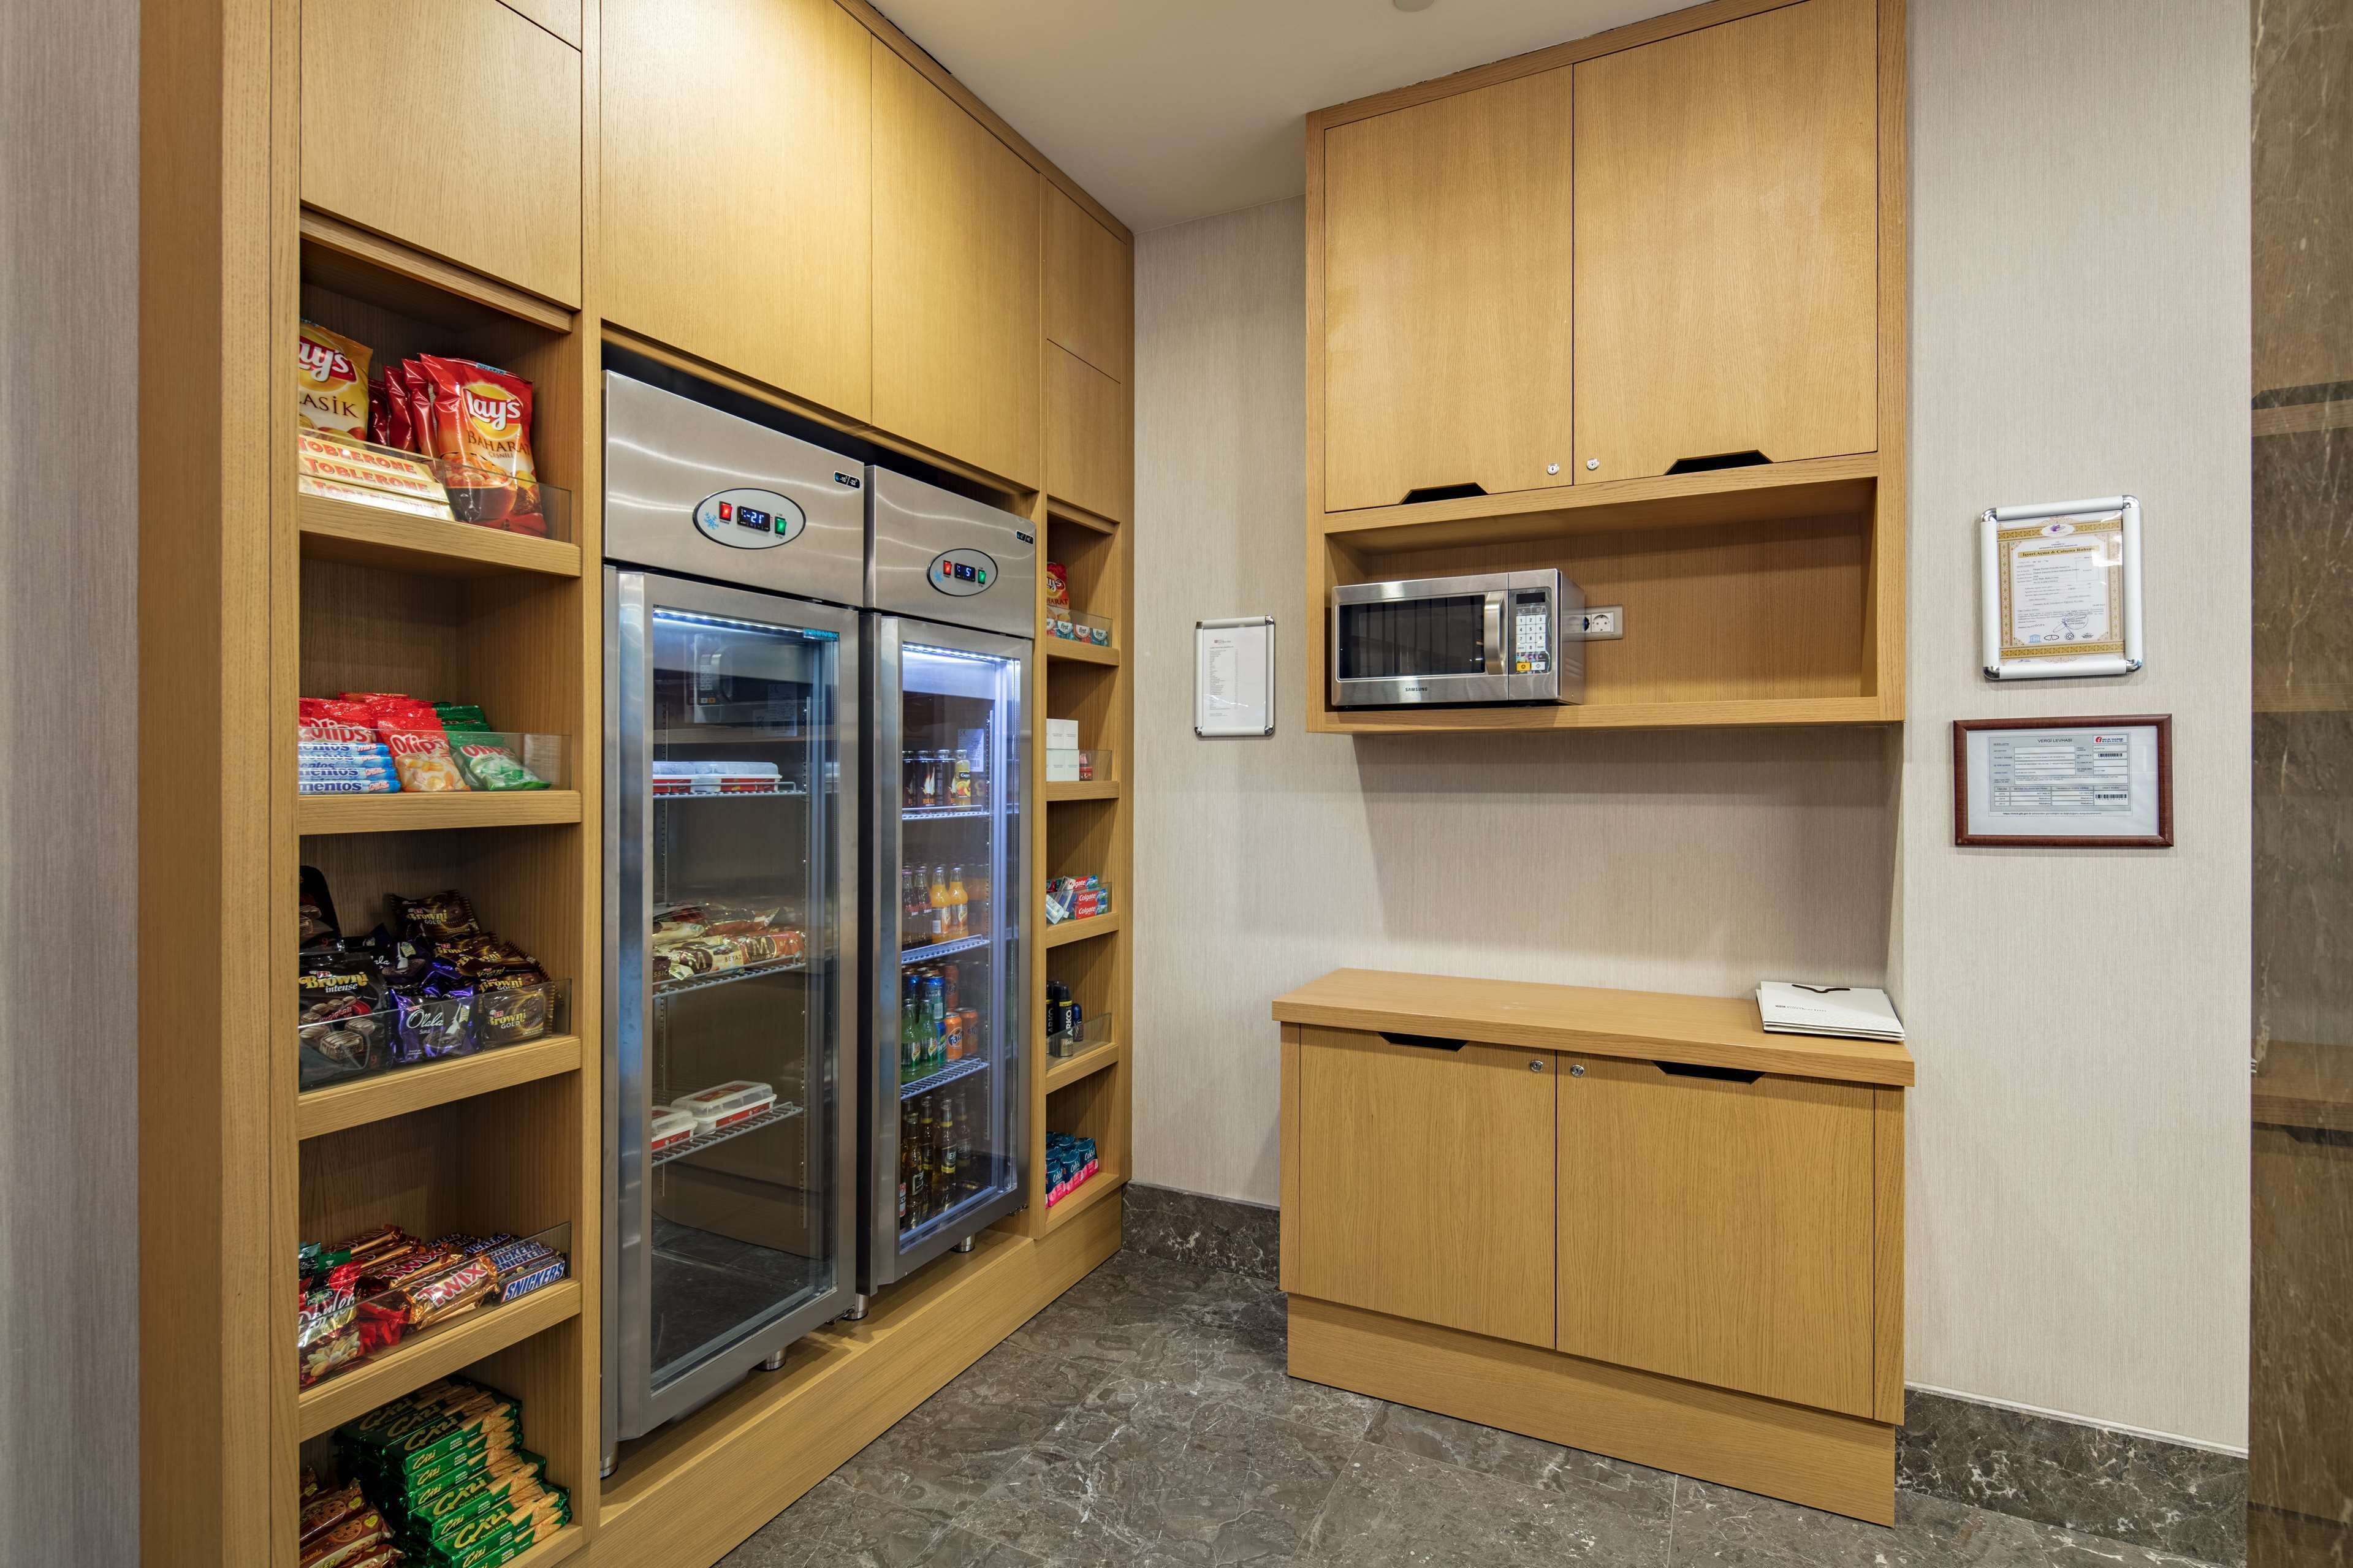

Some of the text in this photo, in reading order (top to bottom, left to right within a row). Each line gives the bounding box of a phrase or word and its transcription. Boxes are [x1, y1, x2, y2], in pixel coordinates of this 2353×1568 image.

[299, 393, 360, 419] ASİK
[466, 390, 521, 431] Lay's
[298, 436, 417, 475] TOBLERONE
[304, 457, 428, 493] TOBLERONE
[309, 718, 368, 743] Olips
[389, 734, 447, 756] Olips
[299, 782, 362, 792] mentos
[1079, 893, 1096, 902] Colgate
[1079, 906, 1095, 915] Colgate
[724, 954, 742, 963] BEYAZ
[298, 971, 369, 989] Browni
[325, 983, 358, 993] intense
[501, 1021, 520, 1029] GOLD
[490, 1241, 542, 1265] NICKERS
[413, 1262, 488, 1309] TWIX
[504, 1260, 566, 1300] SNICKERS
